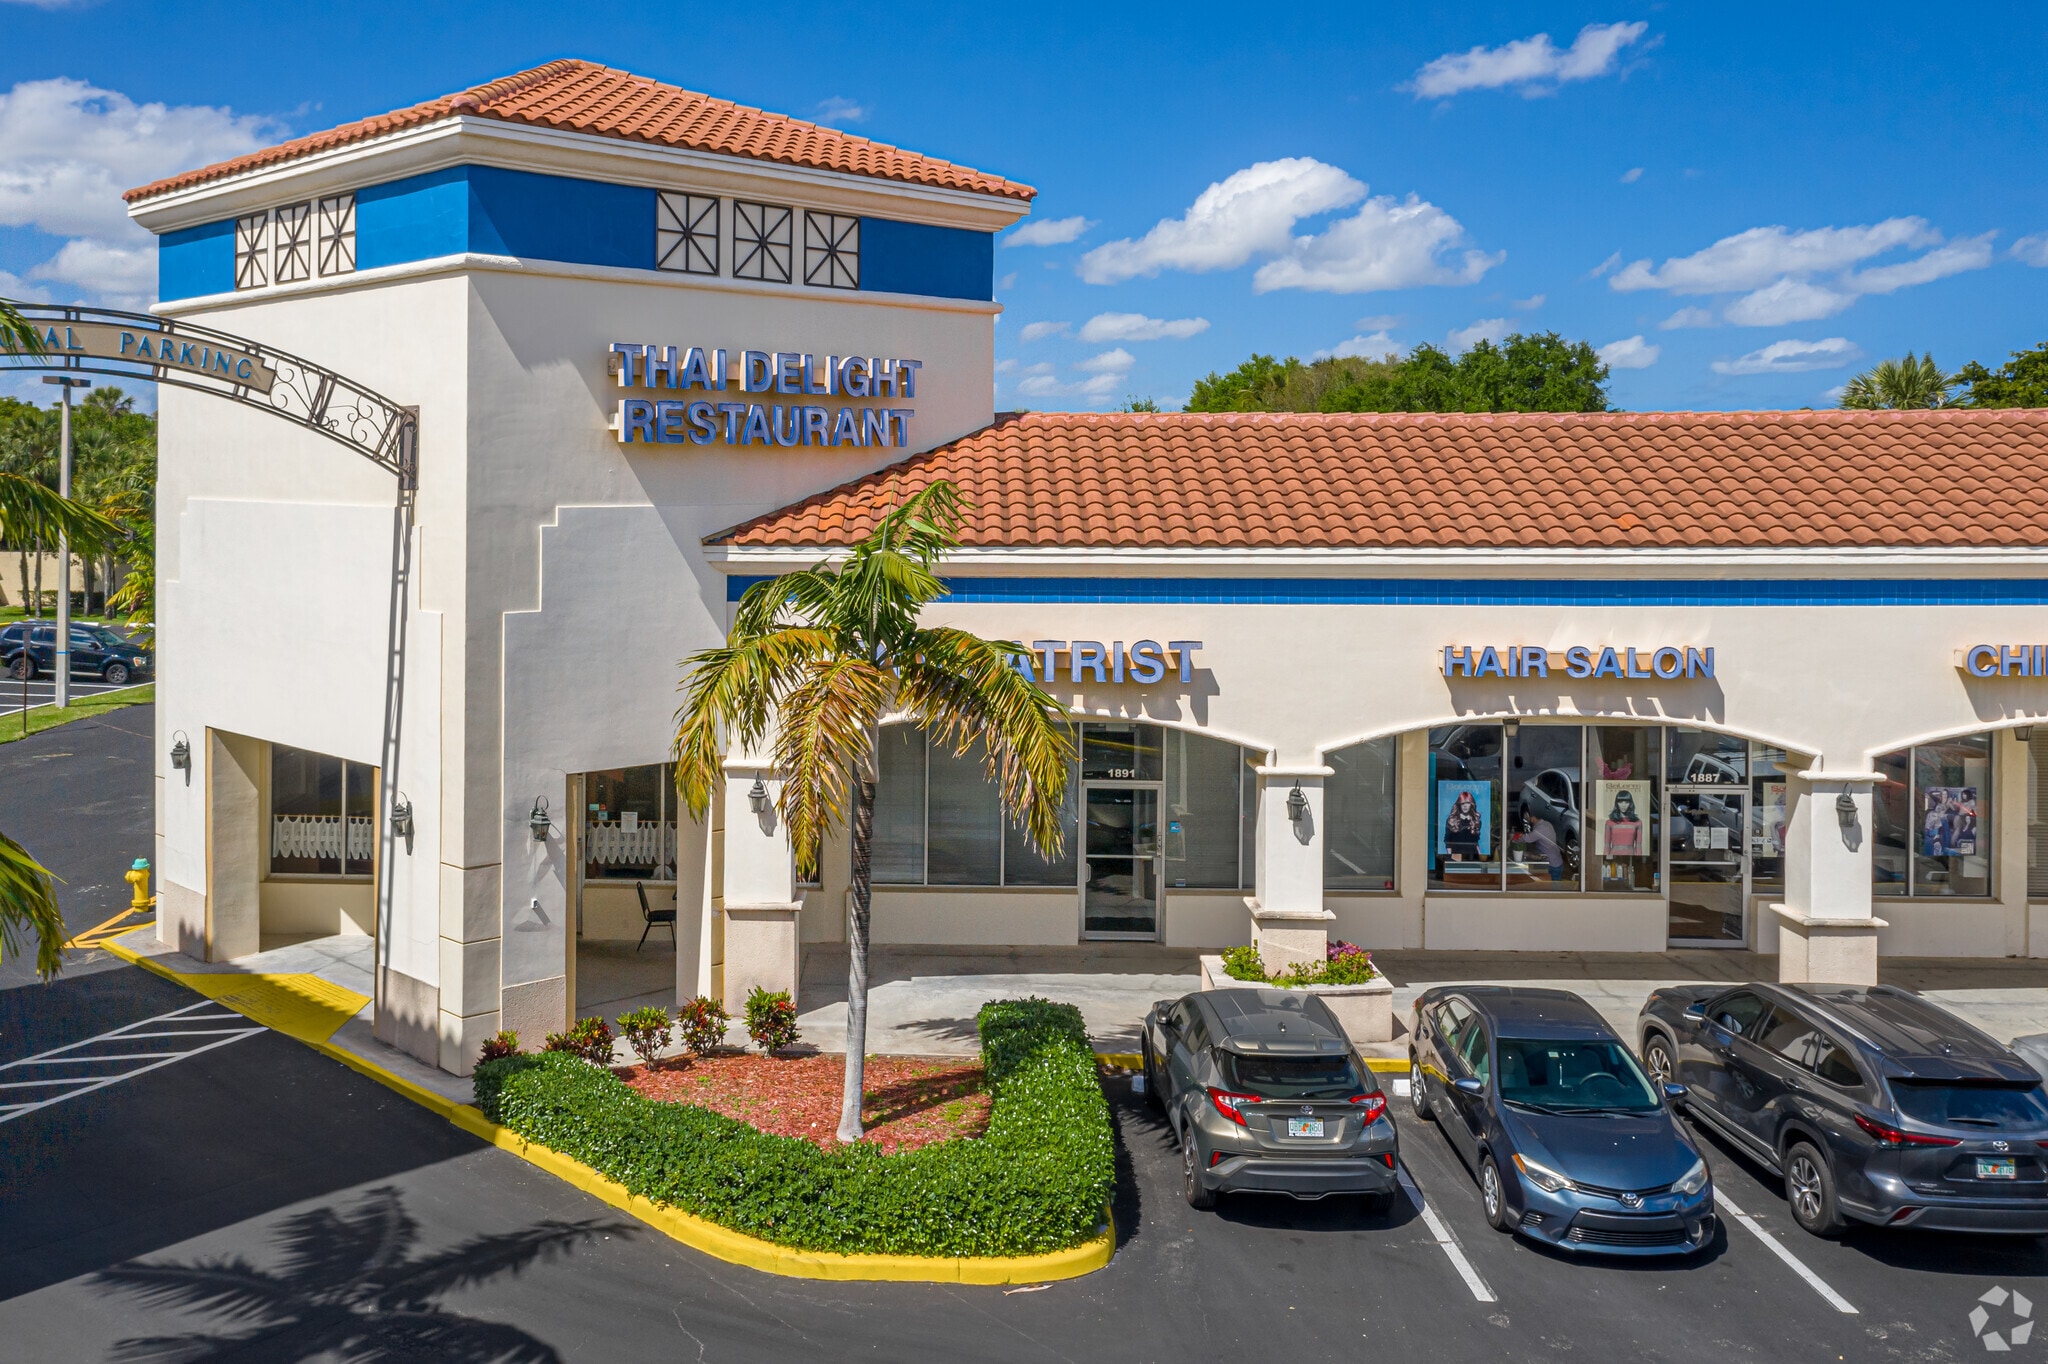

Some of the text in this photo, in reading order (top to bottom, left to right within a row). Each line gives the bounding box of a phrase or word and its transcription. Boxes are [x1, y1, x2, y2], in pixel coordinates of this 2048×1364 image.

[119, 331, 253, 379] PARKING
[609, 343, 923, 398] THAI DELIGHT
[618, 399, 915, 447] RESTAURANT
[1444, 646, 1715, 679] HAIR SALON
[1966, 644, 2048, 677] CHI
[1107, 768, 1136, 778] 1891
[1690, 773, 1720, 783] 1887
